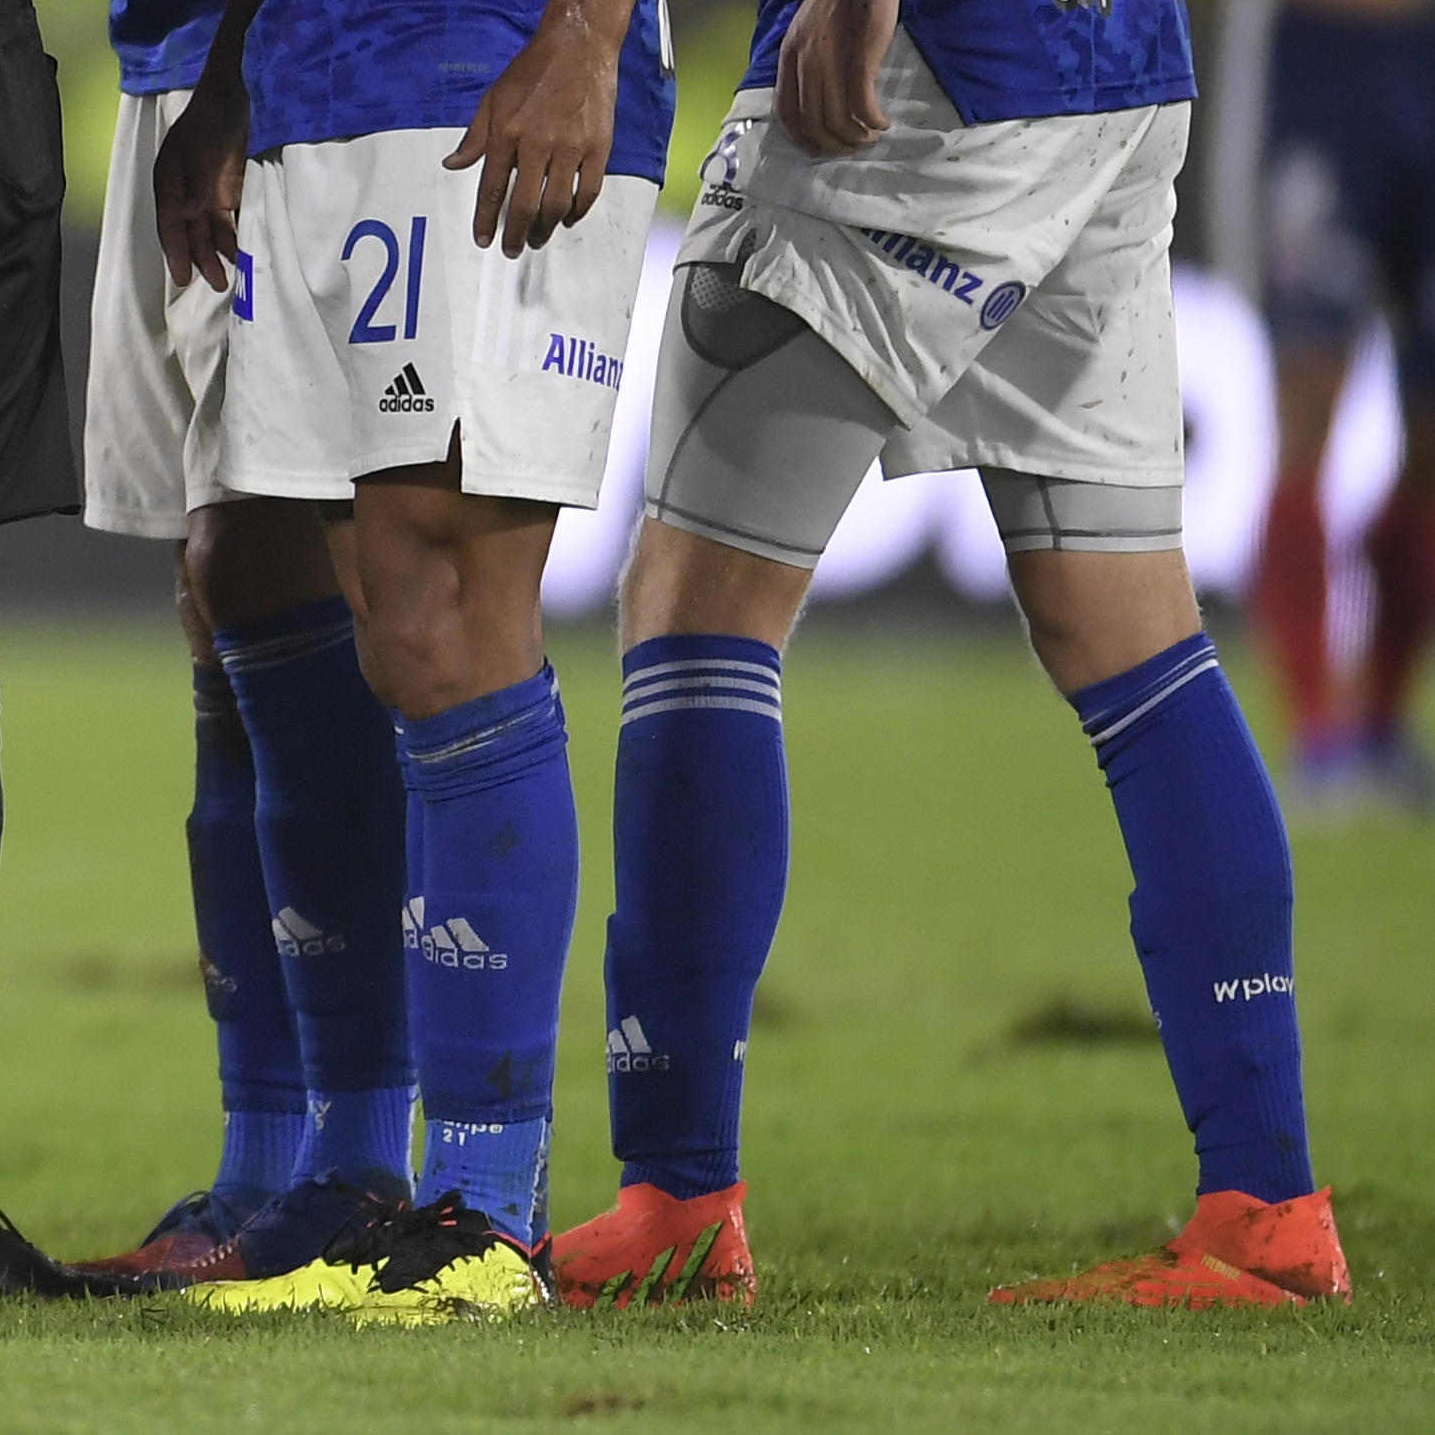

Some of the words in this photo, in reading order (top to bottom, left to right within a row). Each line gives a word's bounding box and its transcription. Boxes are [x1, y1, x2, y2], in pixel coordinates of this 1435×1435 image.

[341, 217, 427, 344] 21
[380, 393, 435, 412] adidas
[442, 1128, 466, 1147] 21
